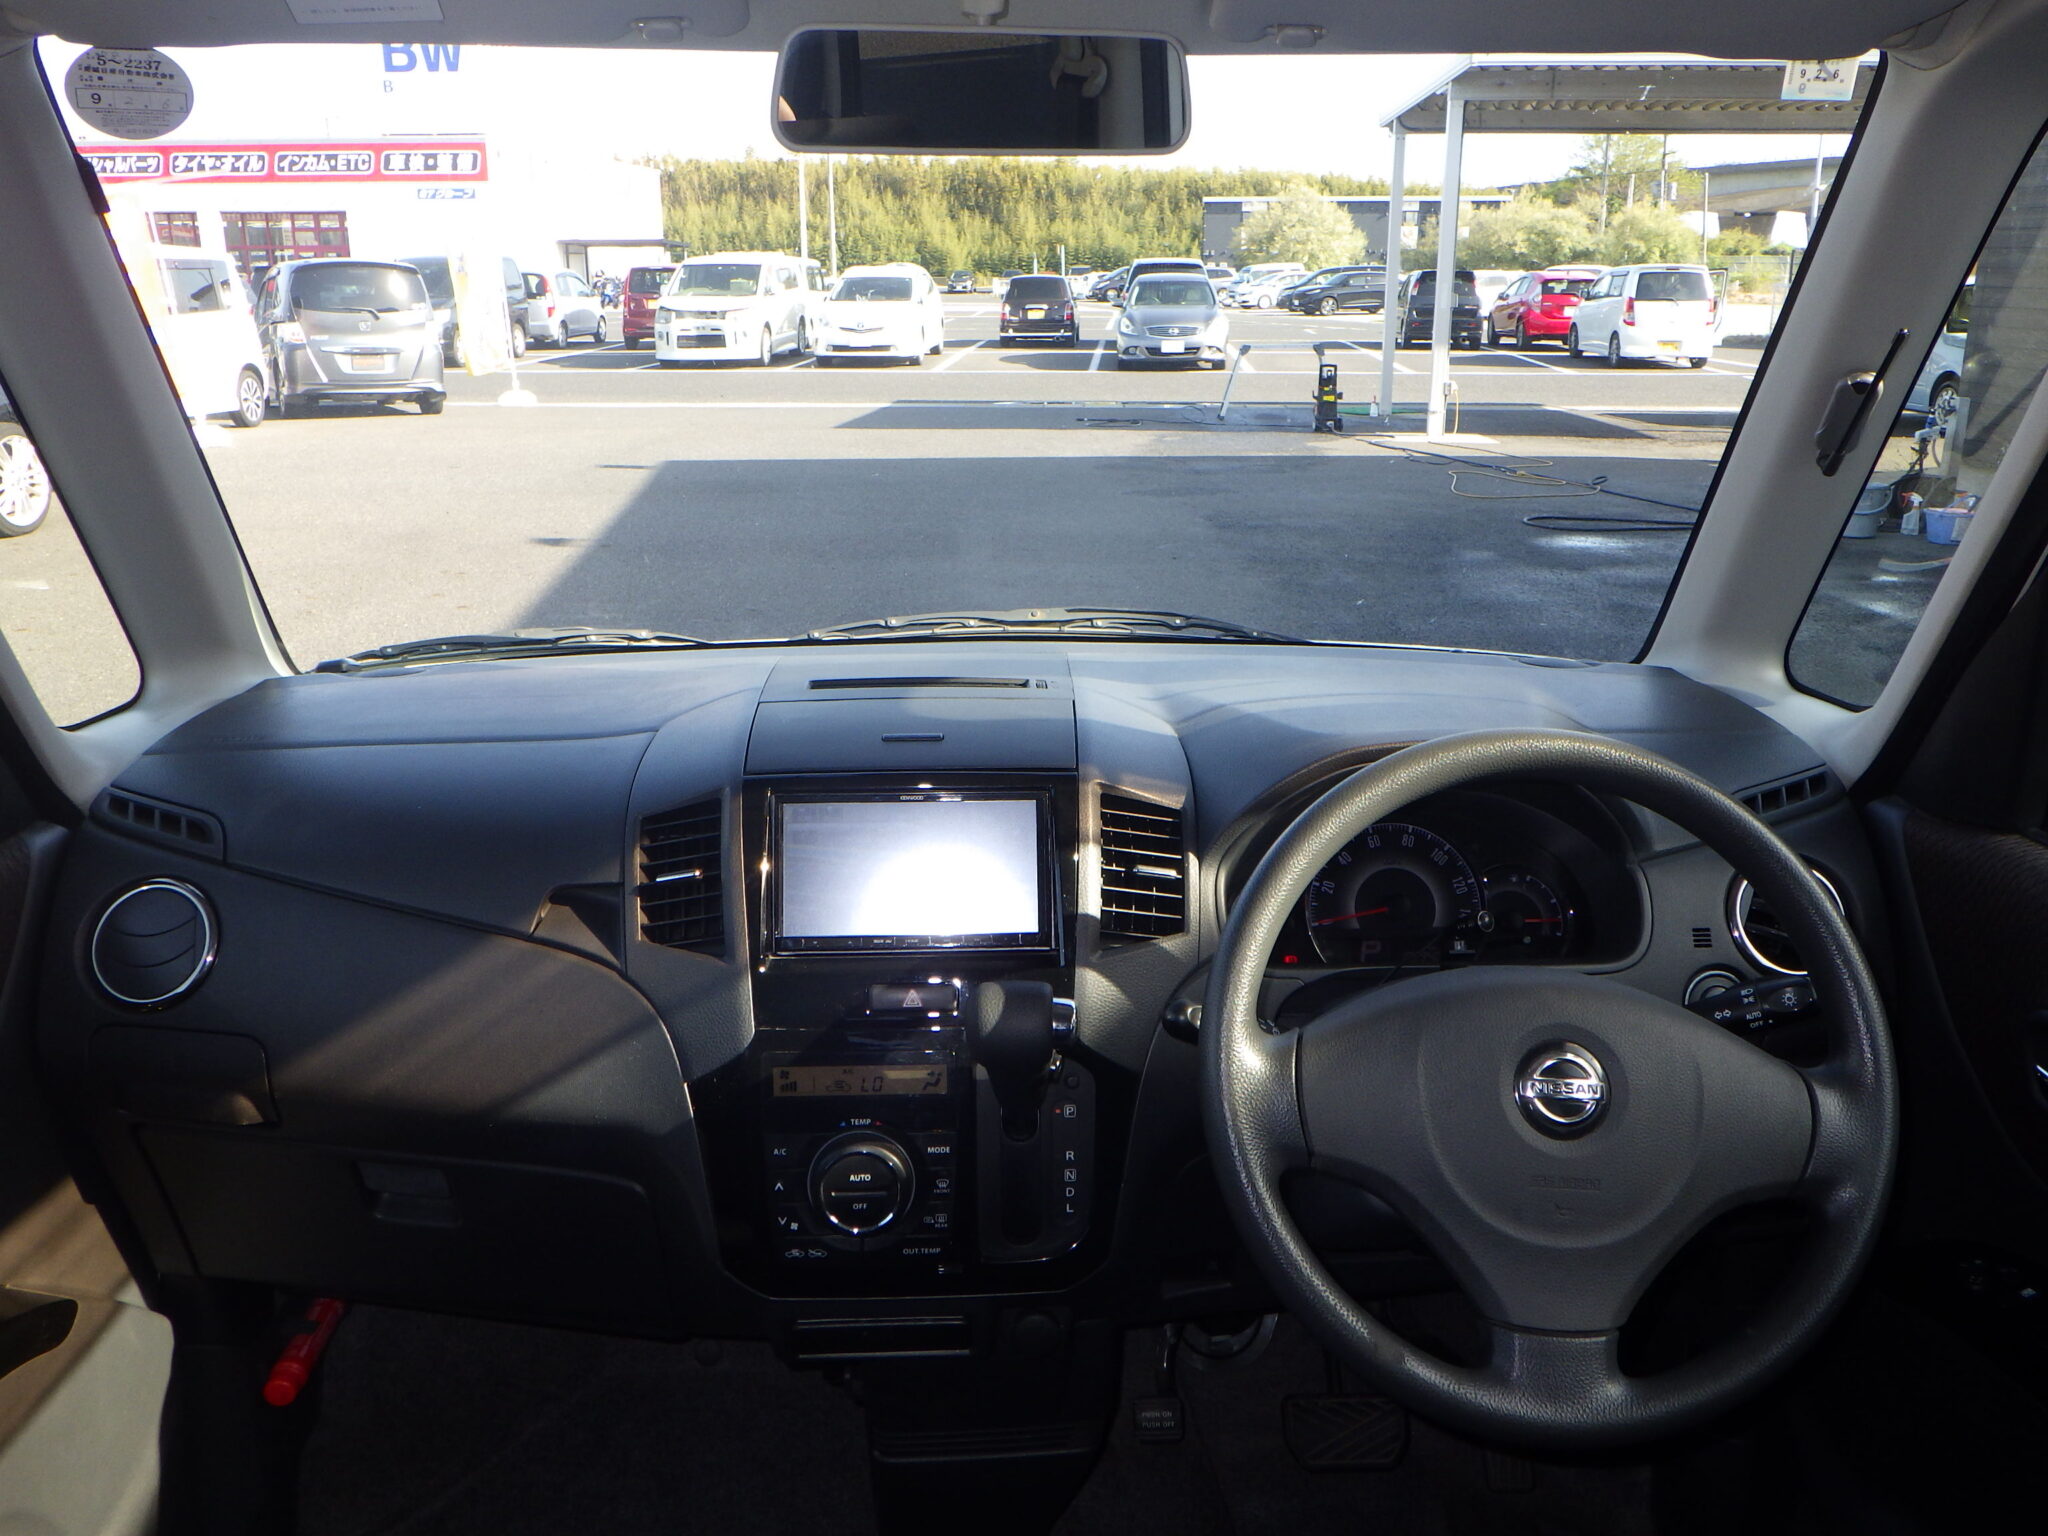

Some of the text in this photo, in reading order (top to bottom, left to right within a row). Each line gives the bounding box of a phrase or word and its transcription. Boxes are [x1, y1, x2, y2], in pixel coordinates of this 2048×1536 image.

[91, 93, 102, 105] 9
[1366, 834, 1381, 849] 60
[1401, 834, 1415, 848] 80
[1430, 847, 1449, 867] 100
[1321, 880, 1336, 895] 20
[1451, 876, 1468, 895] 120
[1530, 1081, 1599, 1095] NISSAN
[850, 1118, 872, 1126] TEMP
[773, 1148, 787, 1156] A/C
[927, 1146, 951, 1154] MODE
[1066, 1151, 1075, 1160] R
[849, 1174, 872, 1182] AUTO
[1066, 1187, 1075, 1197] D
